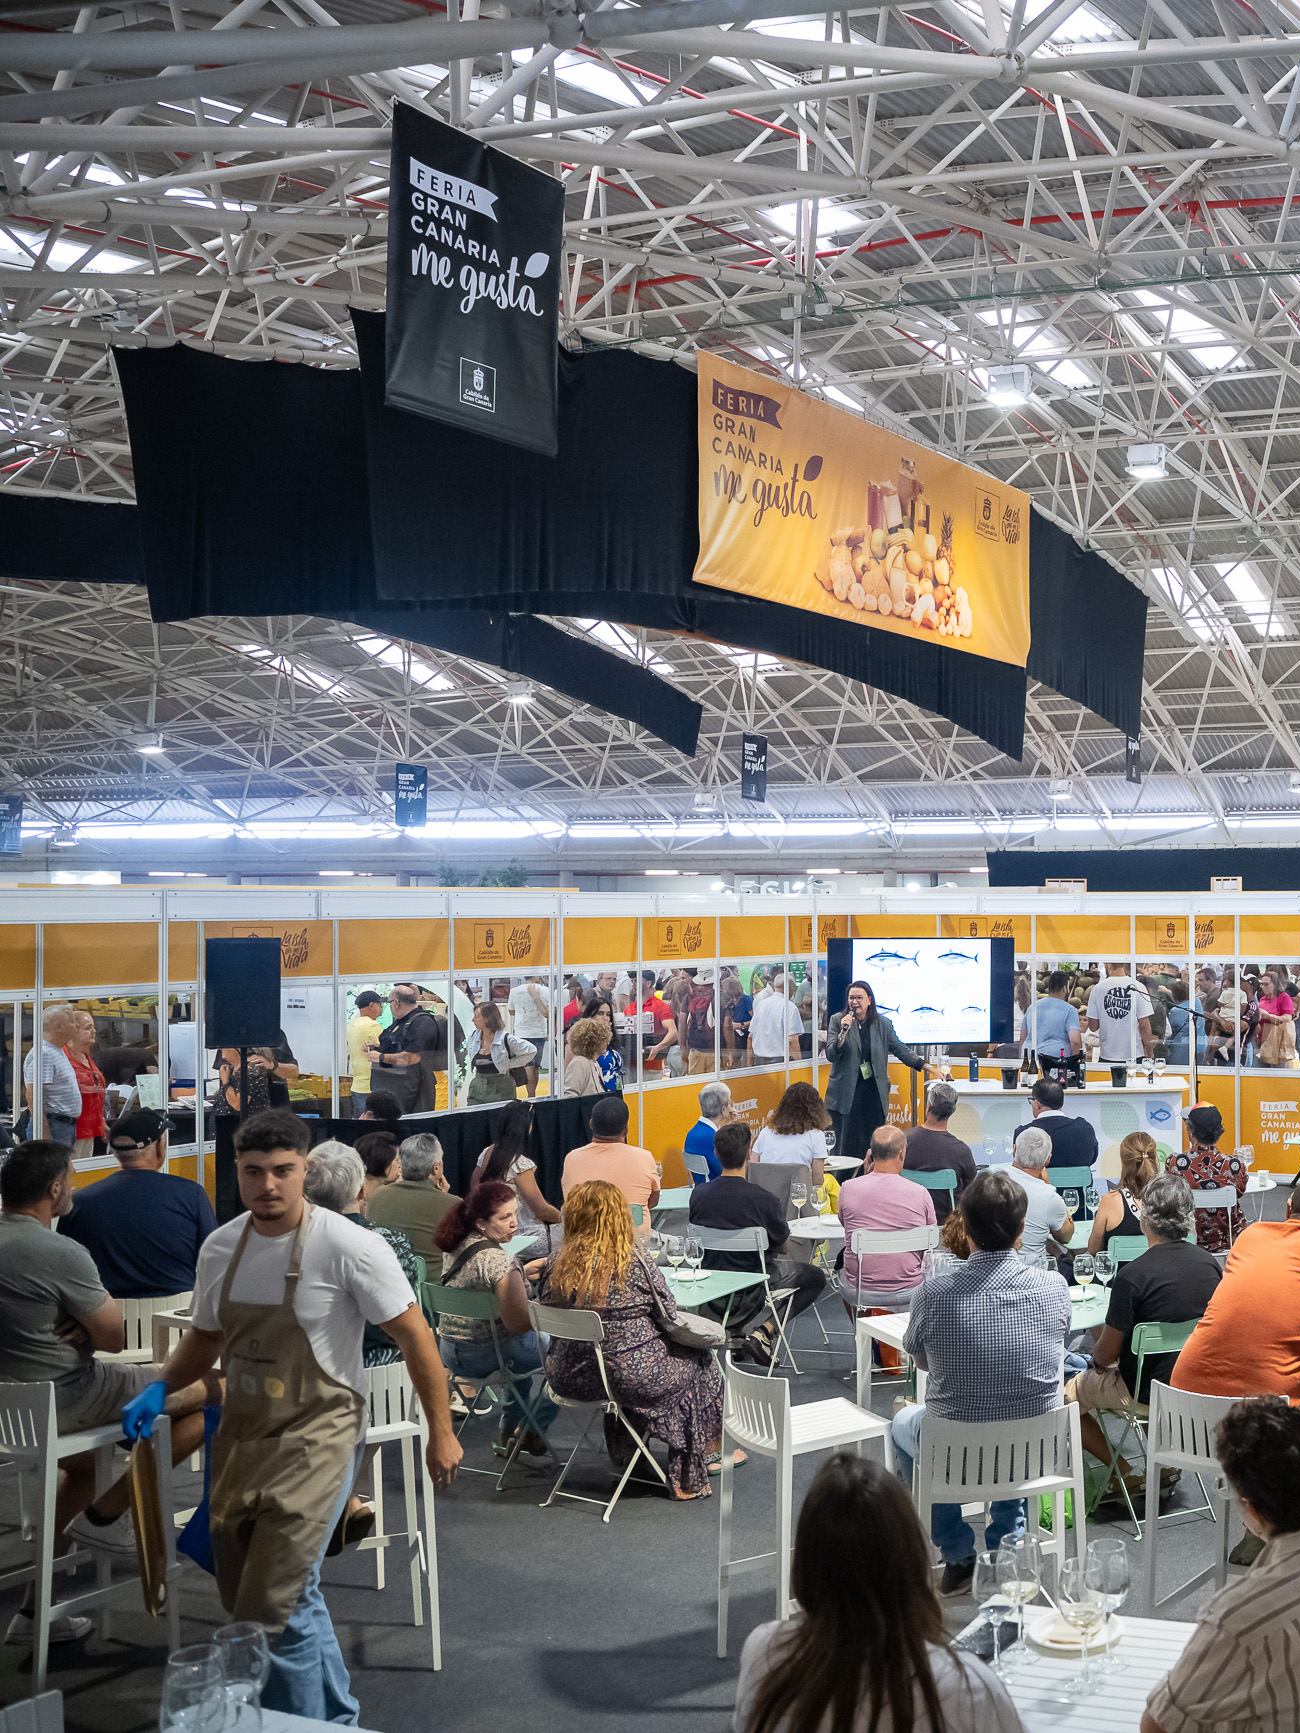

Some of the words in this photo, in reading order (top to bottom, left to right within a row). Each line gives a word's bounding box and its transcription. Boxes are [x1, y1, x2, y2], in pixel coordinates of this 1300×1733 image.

[417, 168, 477, 207] FERIA
[411, 192, 467, 231] GRAN
[411, 215, 500, 267] CANARIA
[411, 242, 454, 288] me
[460, 256, 544, 317] gusta
[718, 388, 765, 418] FERIA
[713, 412, 757, 444] GRAN
[712, 436, 784, 476] CANARIA
[714, 463, 747, 505] me
[752, 462, 817, 527] gusta
[281, 930, 292, 947] La
[292, 928, 309, 949] isla
[281, 947, 308, 969] Vida
[1103, 995, 1132, 1011] BROTHER
[1106, 1008, 1129, 1020] HOOD
[737, 1112, 750, 1120] RAN
[1261, 1112, 1286, 1120] GRAN
[1261, 1120, 1300, 1129] CANARIA
[1261, 1129, 1281, 1144] me
